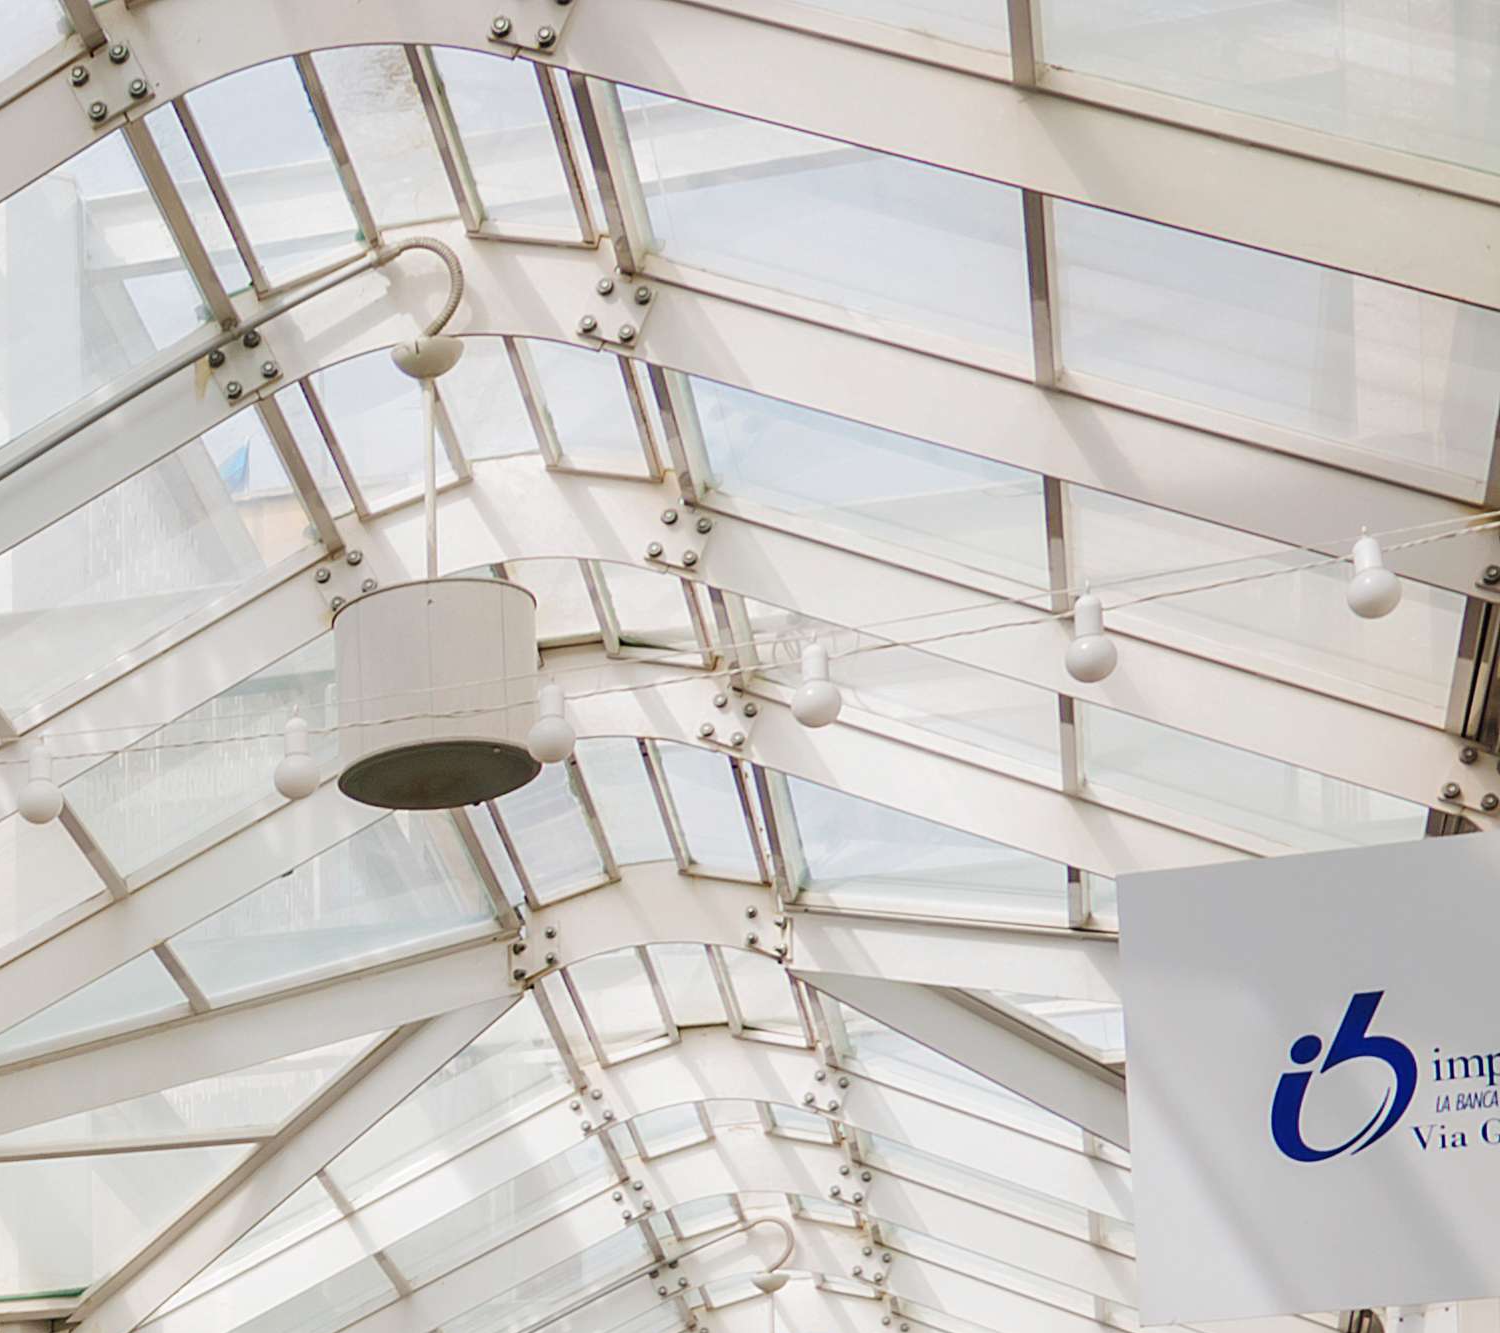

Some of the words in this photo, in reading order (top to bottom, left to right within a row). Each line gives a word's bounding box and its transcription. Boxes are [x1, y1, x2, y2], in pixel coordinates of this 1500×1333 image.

[1436, 1096, 1450, 1114] LA
[1455, 1090, 1500, 1112] BANCA
[1412, 1124, 1468, 1151] Via
